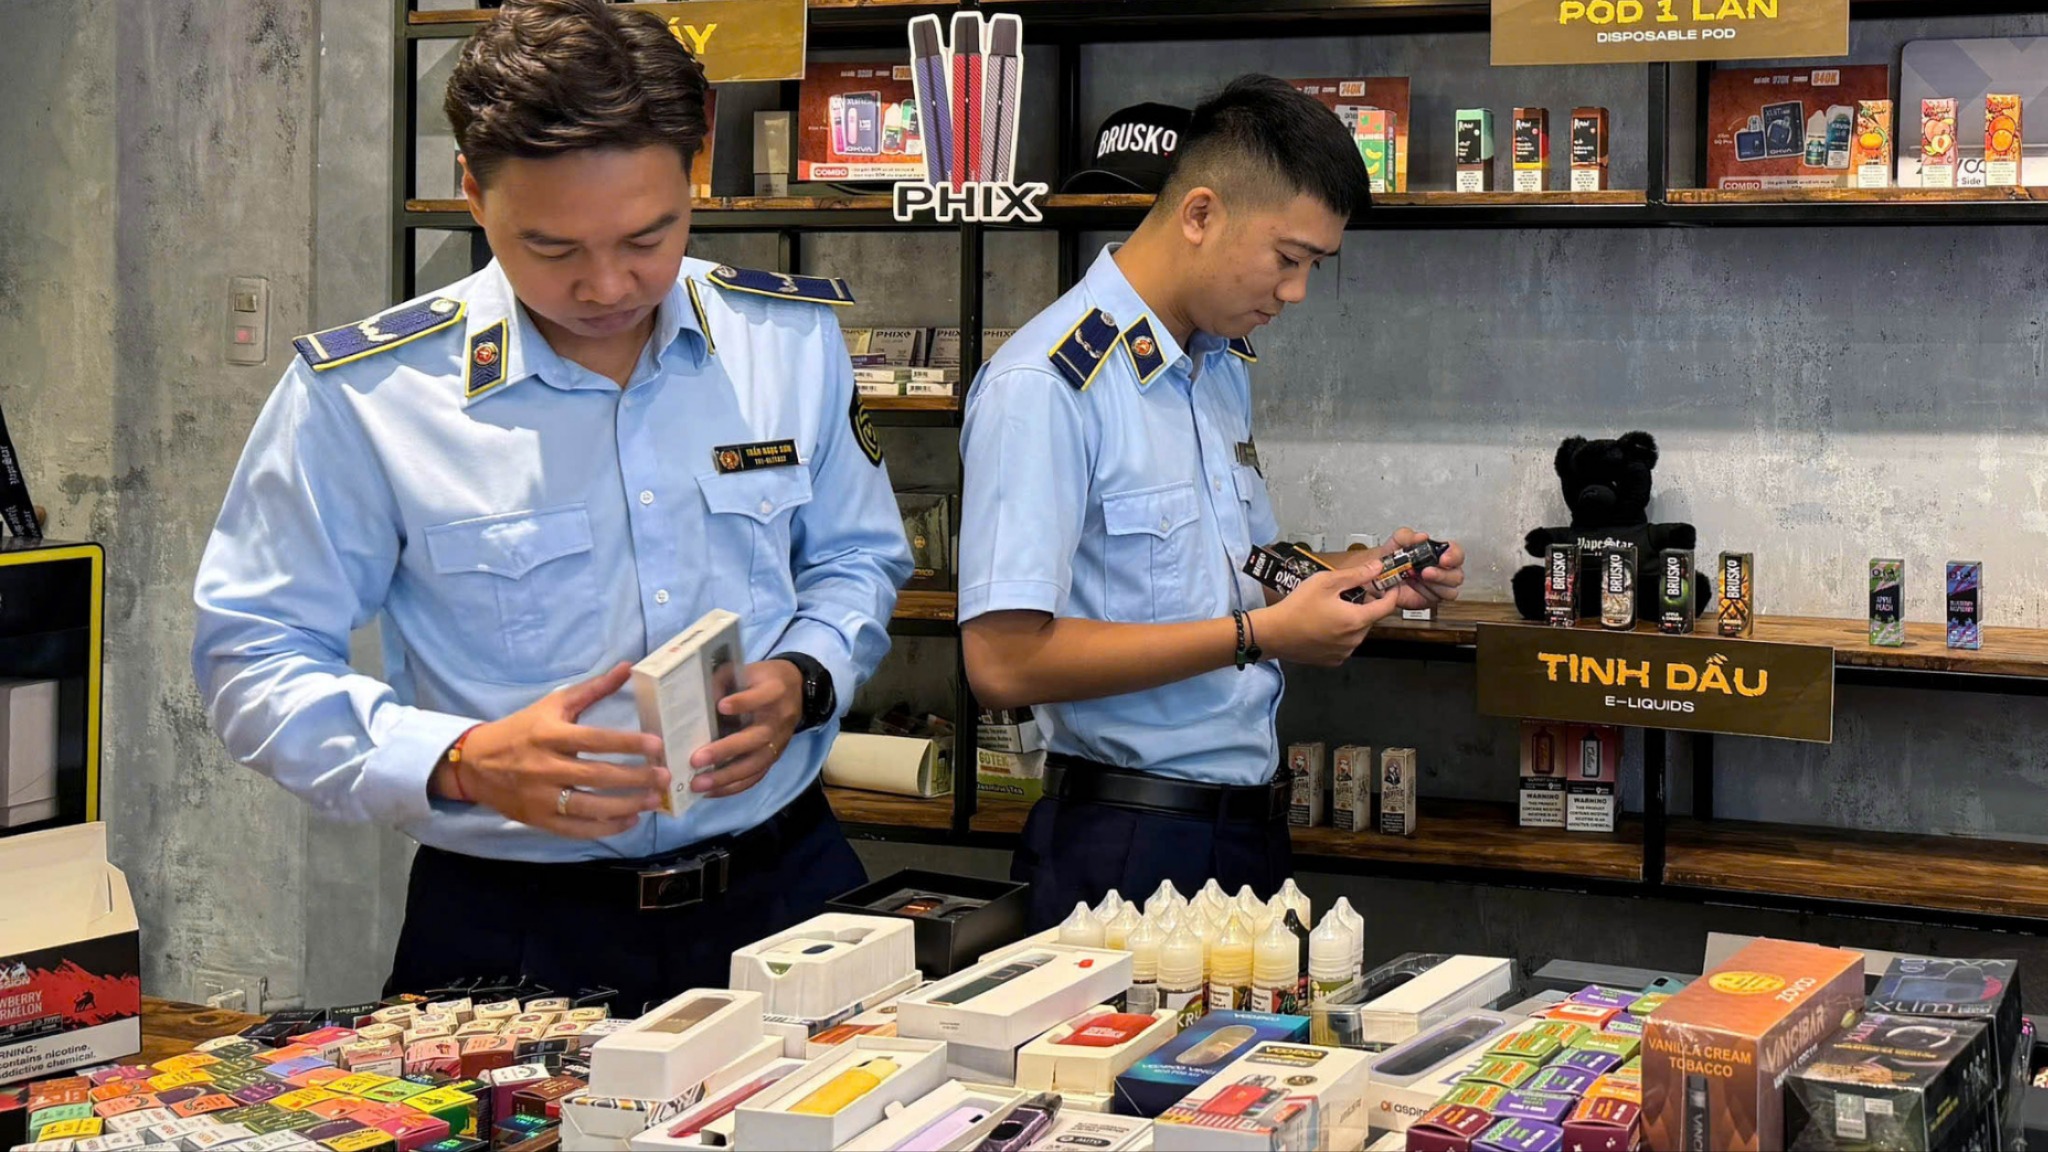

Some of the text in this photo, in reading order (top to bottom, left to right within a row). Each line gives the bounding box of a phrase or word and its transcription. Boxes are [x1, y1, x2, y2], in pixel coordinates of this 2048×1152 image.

[1559, 0, 1643, 25] POD
[1656, 0, 1678, 22] 1
[1597, 28, 1736, 43] DISPOSABLE POD
[1097, 122, 1178, 159] BRUSKO
[815, 168, 848, 176] COMBO
[1961, 177, 1981, 186] Side
[1724, 182, 1760, 190] COMBO
[895, 184, 1041, 219] PHIX
[1275, 571, 1301, 590] USKO
[1553, 552, 1566, 590] BRUSKO
[1610, 554, 1623, 592] BRUSKO
[1667, 557, 1680, 596] BRUSKO
[1726, 560, 1740, 598] BRUSKO
[1538, 652, 1650, 688] TINH
[1605, 695, 1695, 713] E-LIQUIDS
[1648, 1036, 1752, 1065] VANILLA CREAM
[0, 1064, 43, 1080] ddictive
[1668, 1056, 1733, 1078] TOBACCO
